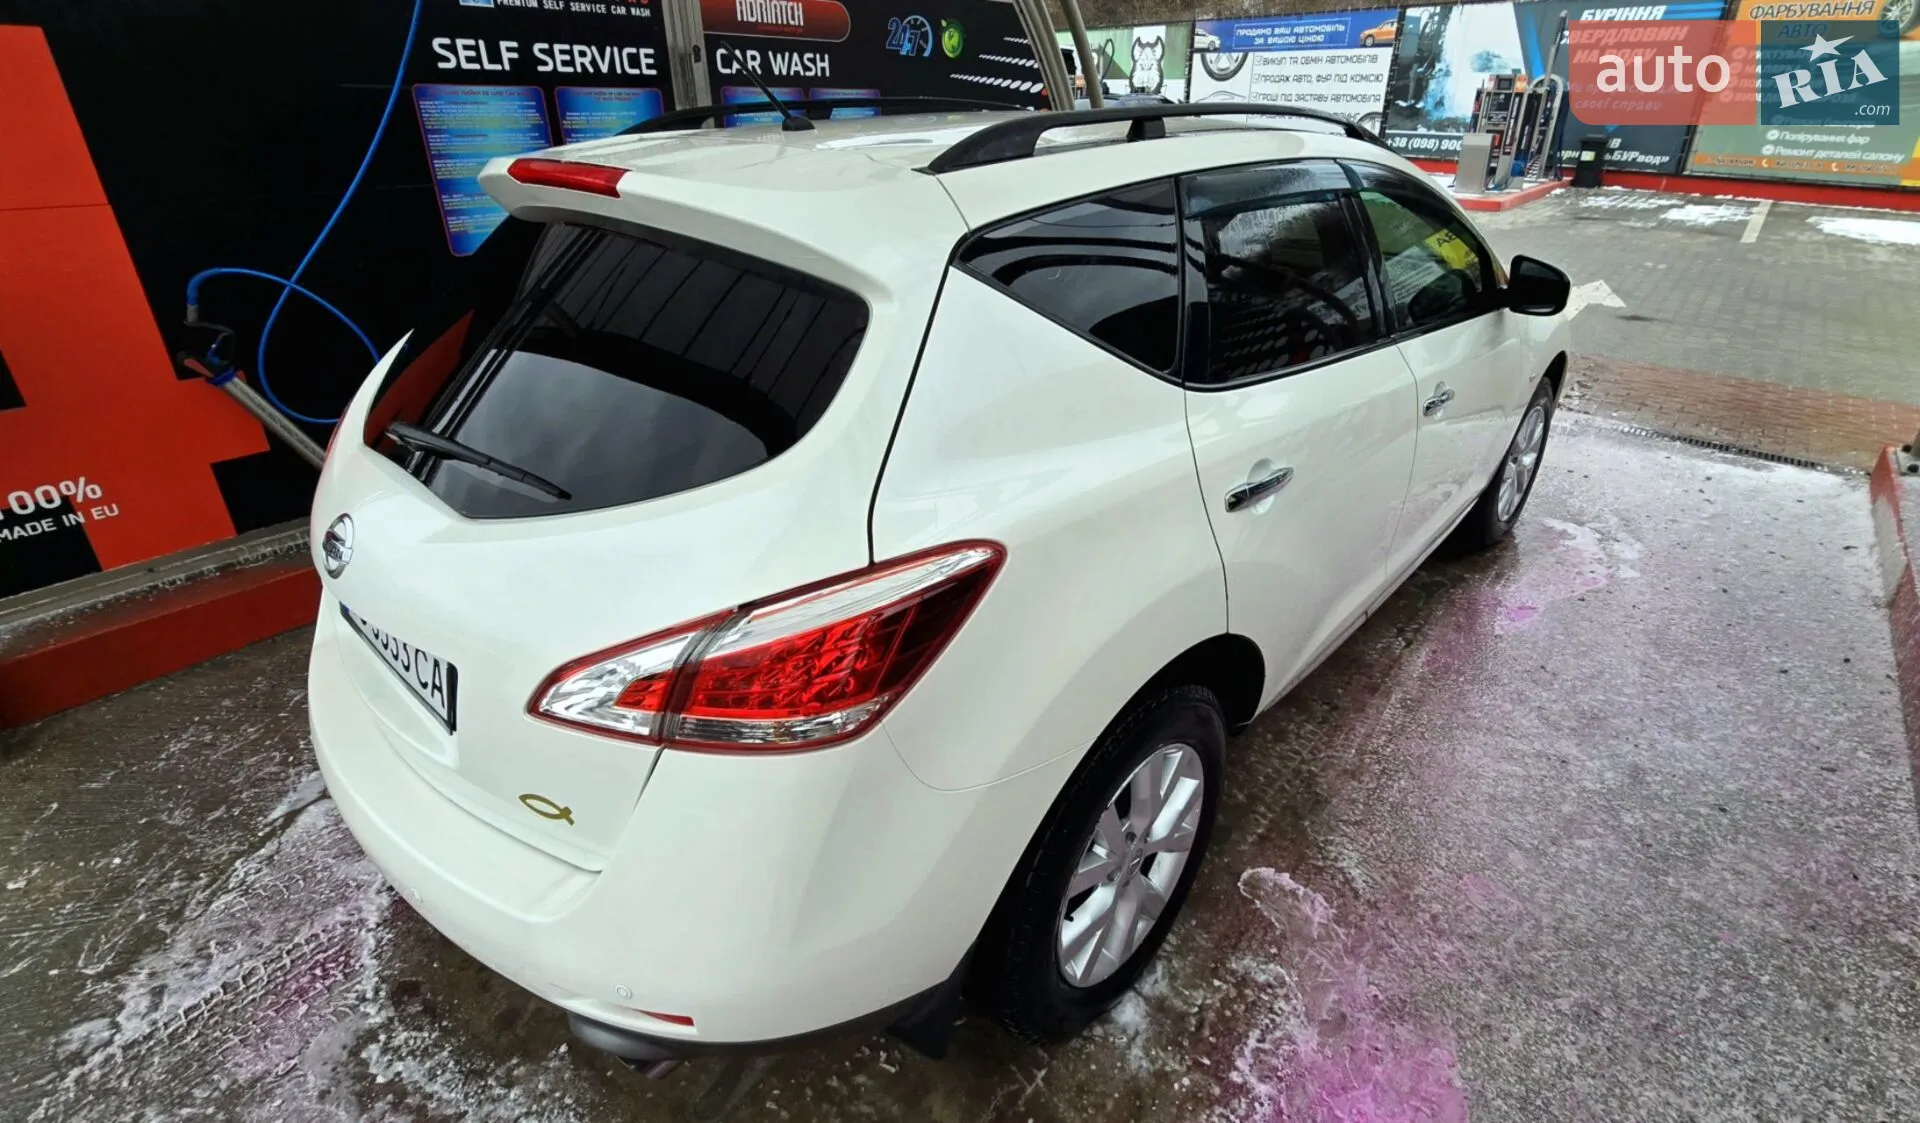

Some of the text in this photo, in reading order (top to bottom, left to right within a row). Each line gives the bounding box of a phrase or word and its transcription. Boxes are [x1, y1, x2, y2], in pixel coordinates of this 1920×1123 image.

[543, 0, 565, 10] SELF
[570, 3, 607, 14] SERVICE
[611, 5, 627, 15] CAR
[630, 8, 651, 17] WASH
[1579, 5, 1667, 23] БУРІННЯ
[1749, 0, 1876, 19] ФАРБУВАННЯ
[1236, 24, 1346, 37] ПРОДАМО ВАШ АВТОМОБІЛЬ
[1254, 34, 1325, 45] ЗА ВАШОЮ ЦІНОЮ
[432, 37, 657, 75] SELF SERVICE
[716, 48, 830, 77] CAR WASH
[1288, 56, 1299, 65] ТА
[1315, 74, 1333, 83] ФУР
[1334, 73, 1348, 82] ПІД
[1386, 136, 1408, 148] +38
[1408, 138, 1440, 152] (098)
[61, 511, 86, 528] IN
[90, 503, 119, 520] EU
